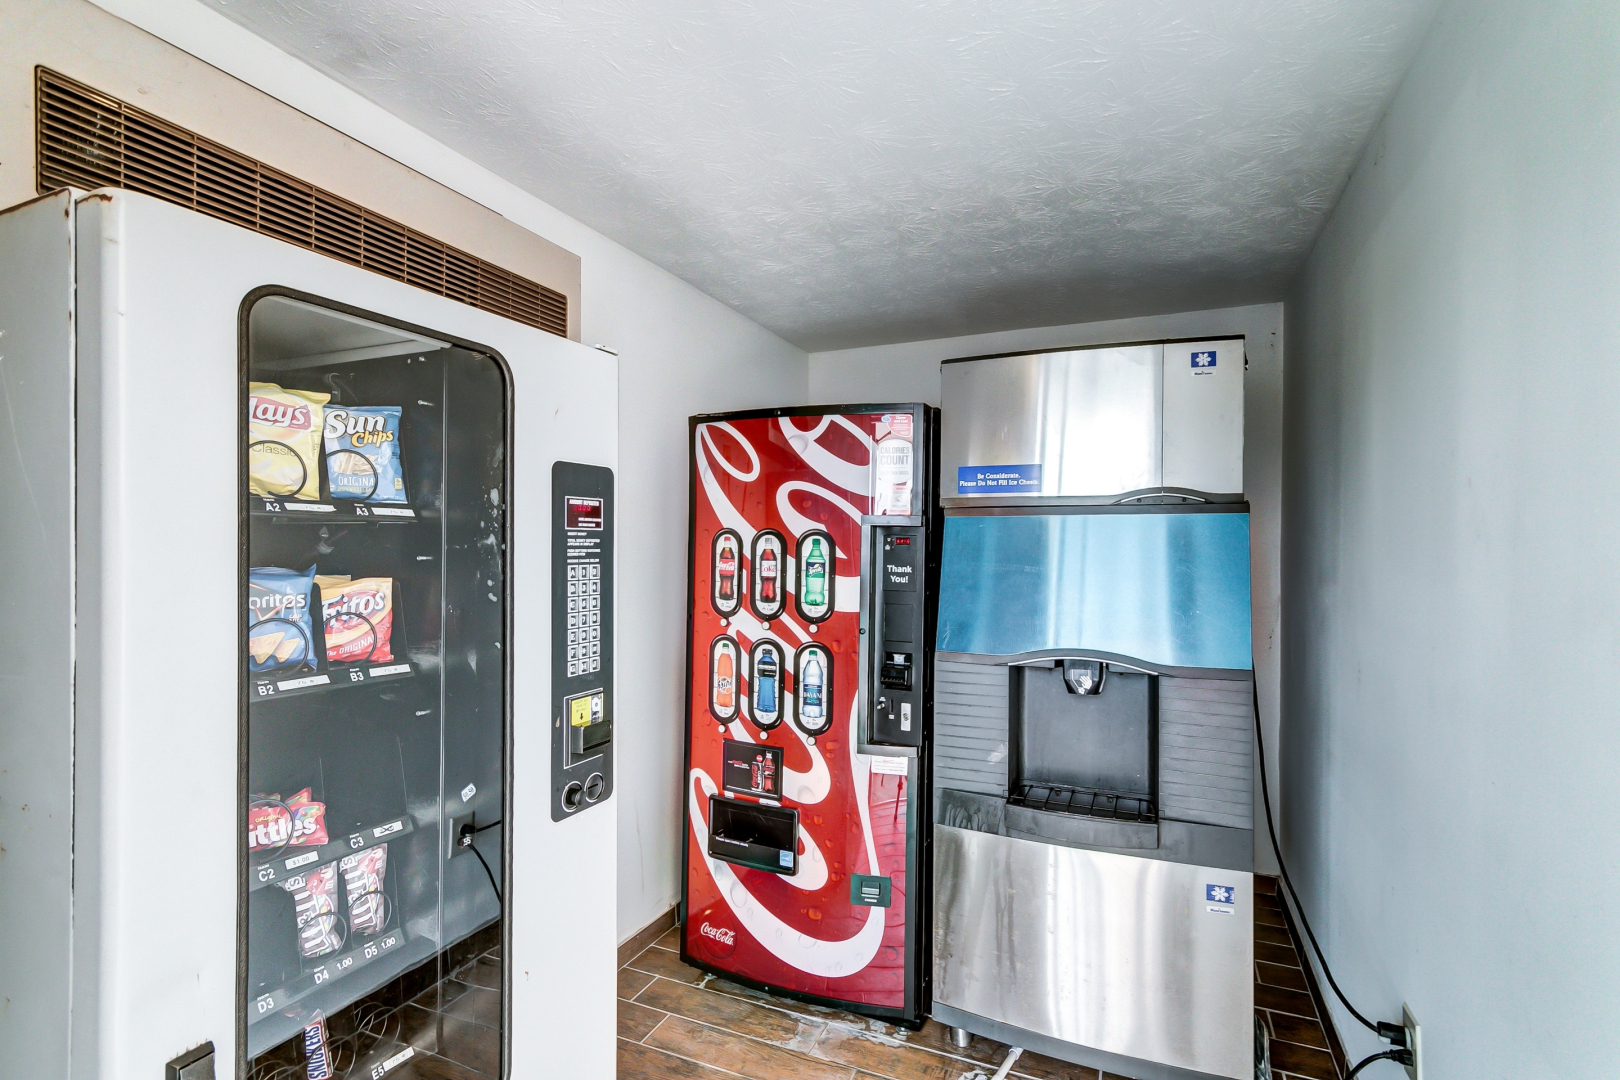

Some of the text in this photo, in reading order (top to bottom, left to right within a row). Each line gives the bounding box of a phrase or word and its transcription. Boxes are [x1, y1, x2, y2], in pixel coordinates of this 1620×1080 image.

[324, 410, 386, 440] Sun
[351, 430, 394, 448] Chips
[880, 446, 910, 454] CALORIES
[880, 455, 910, 465] COUNT
[338, 475, 376, 487] ORIGINA
[265, 502, 282, 512] A2
[356, 507, 369, 516] A3
[761, 564, 776, 573] Coke
[887, 565, 912, 573] Thank
[890, 575, 908, 583] You!
[250, 593, 307, 610] oritos
[322, 591, 386, 628] Fritos
[339, 635, 376, 655] ORIGINA
[350, 672, 364, 682] B3
[257, 685, 275, 696] B2
[249, 815, 319, 848] ittles
[350, 838, 364, 849] C3
[258, 868, 276, 882] C2
[700, 921, 736, 946] Coca-Cola
[381, 937, 396, 950] 1.00
[364, 945, 378, 959] D5
[336, 957, 353, 971] 1.00
[314, 969, 329, 985] D4
[257, 998, 275, 1013] D3
[304, 1025, 327, 1080] SNICKERS
[371, 1067, 385, 1080] E5
